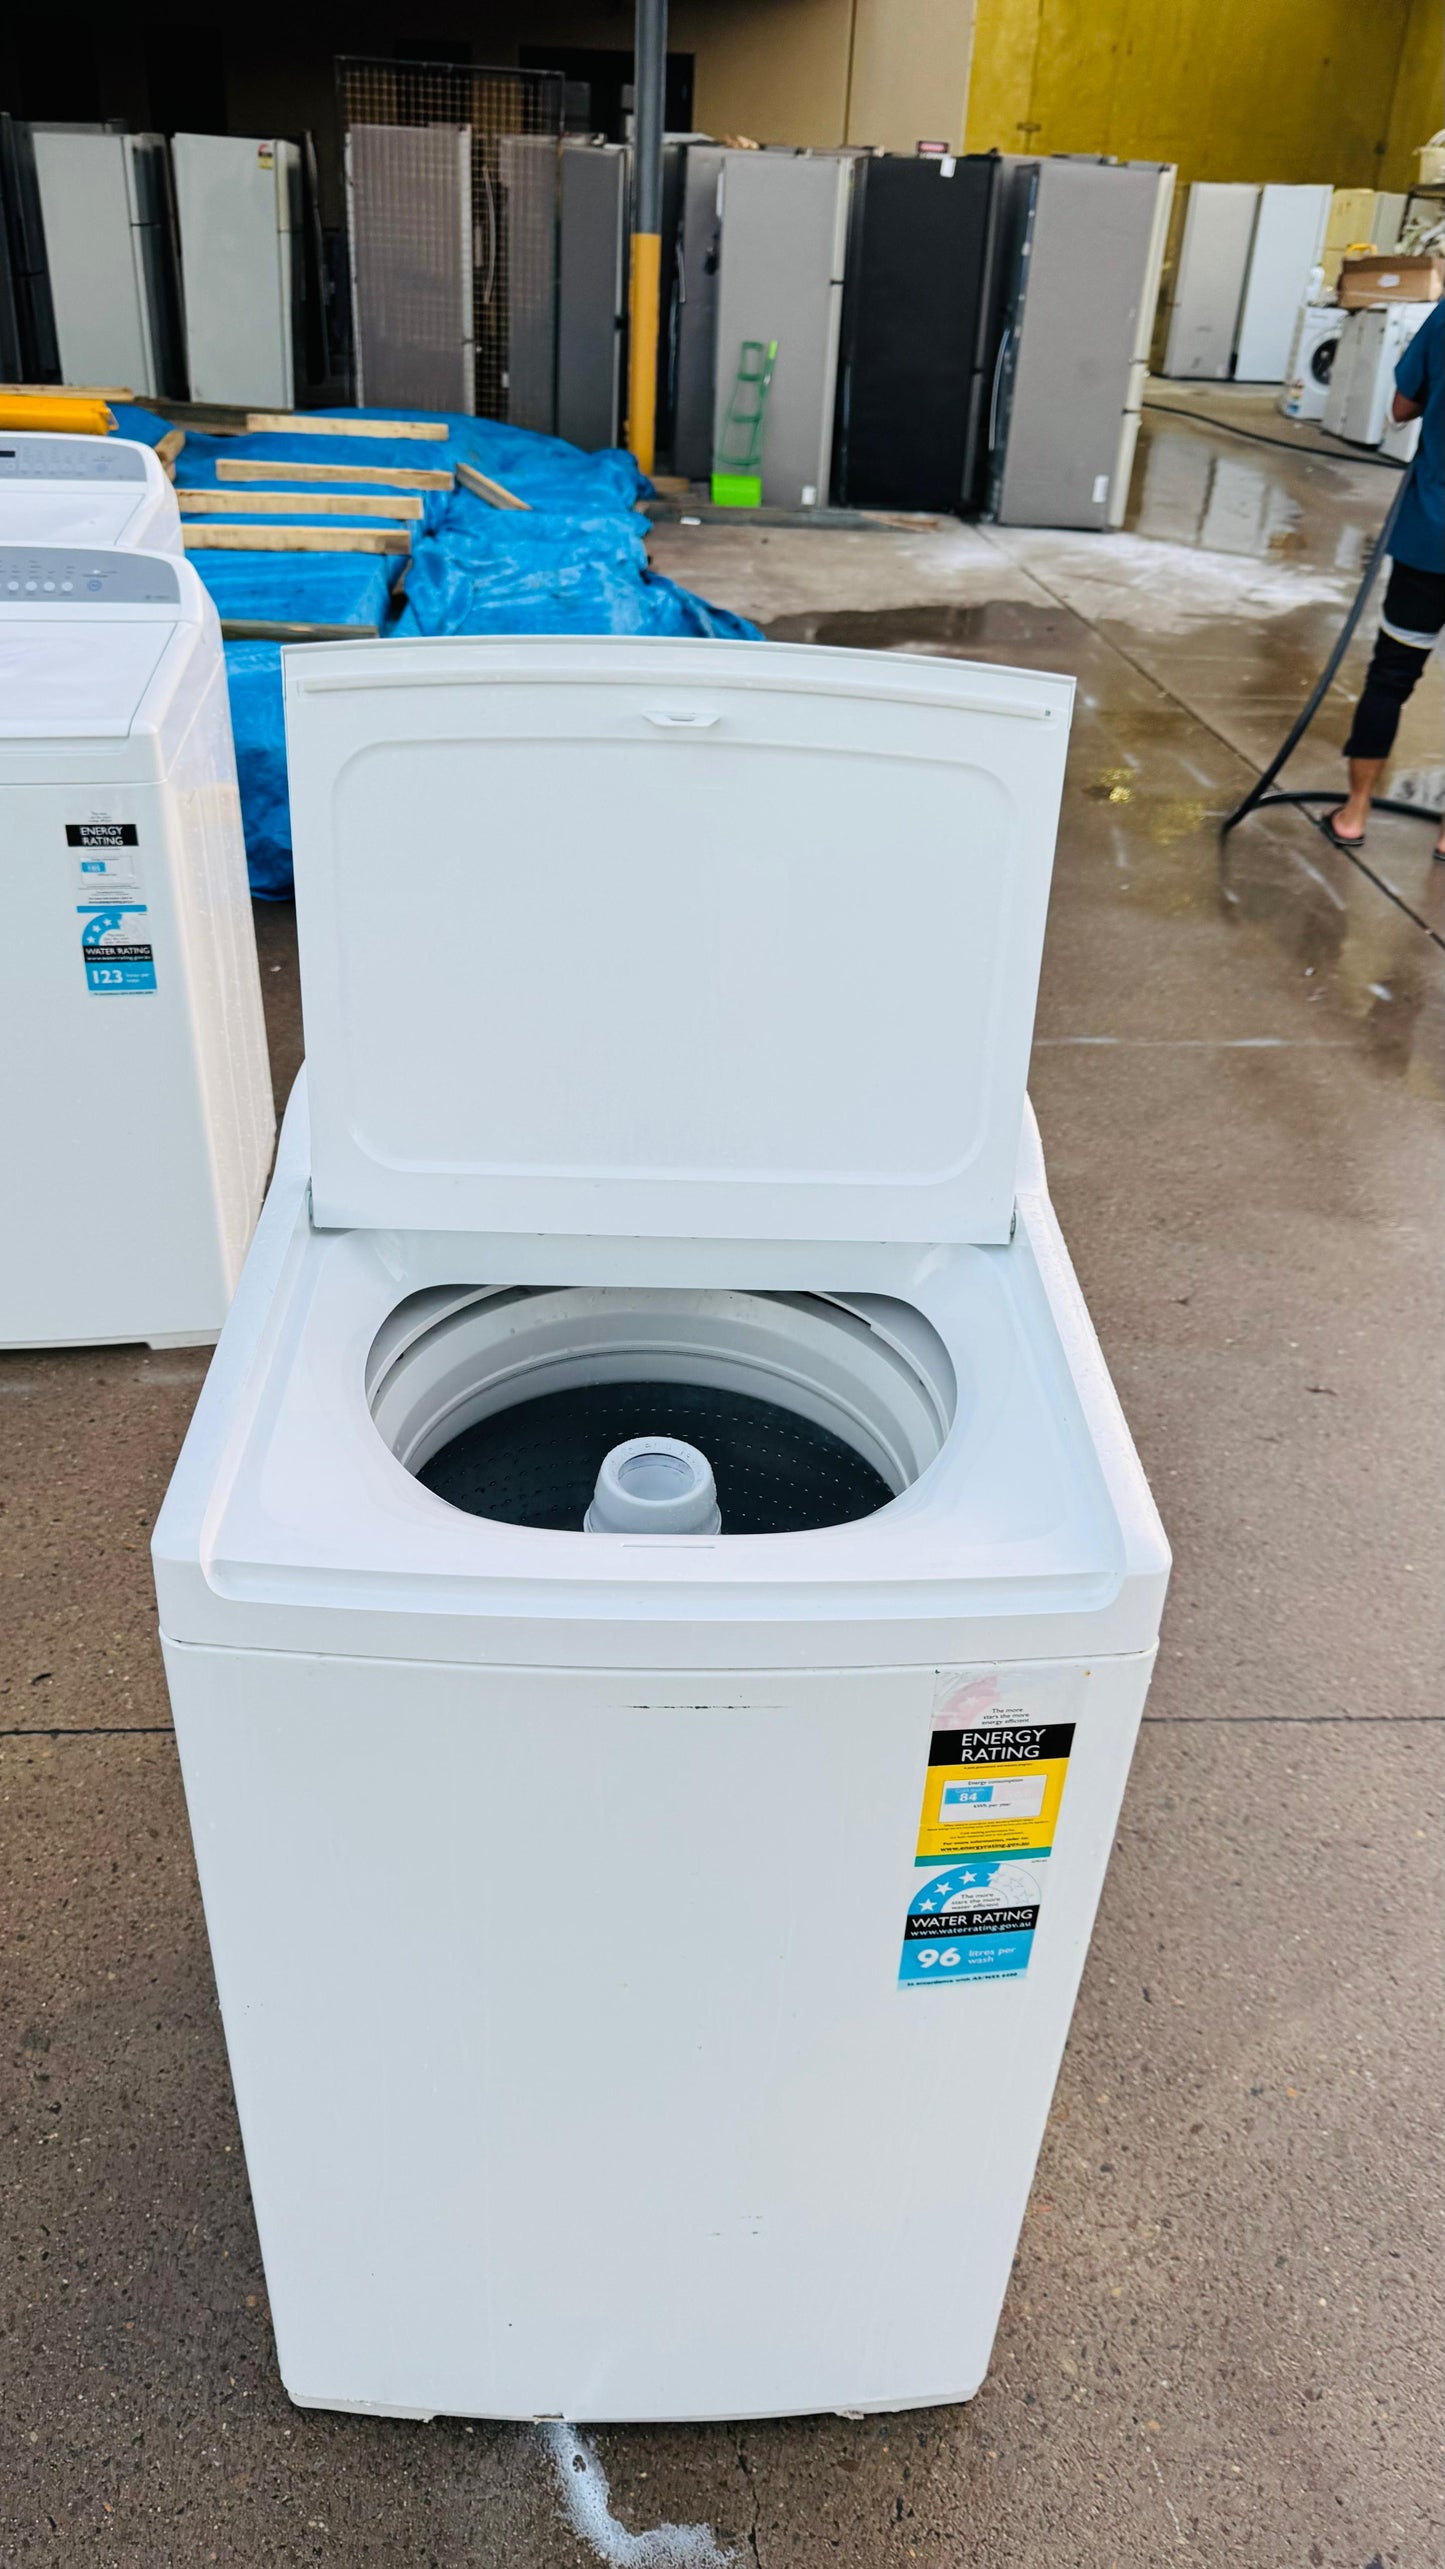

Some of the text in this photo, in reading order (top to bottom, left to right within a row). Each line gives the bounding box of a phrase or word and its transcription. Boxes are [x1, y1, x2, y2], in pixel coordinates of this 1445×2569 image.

[80, 826, 123, 836] ENERGY
[82, 836, 124, 846] RATING
[85, 946, 150, 956] WATER RATING
[92, 969, 124, 984] 123
[961, 1728, 1047, 1747] ENERGY
[961, 1745, 1041, 1762] RATING
[959, 1792, 978, 1802] 84
[911, 1909, 1034, 1929] WATER RATING
[910, 1921, 1032, 1937] www.waterrating.gov.au
[917, 1946, 962, 1969] 96
[968, 1947, 1017, 1957] litres per
[967, 1956, 994, 1964] wash
